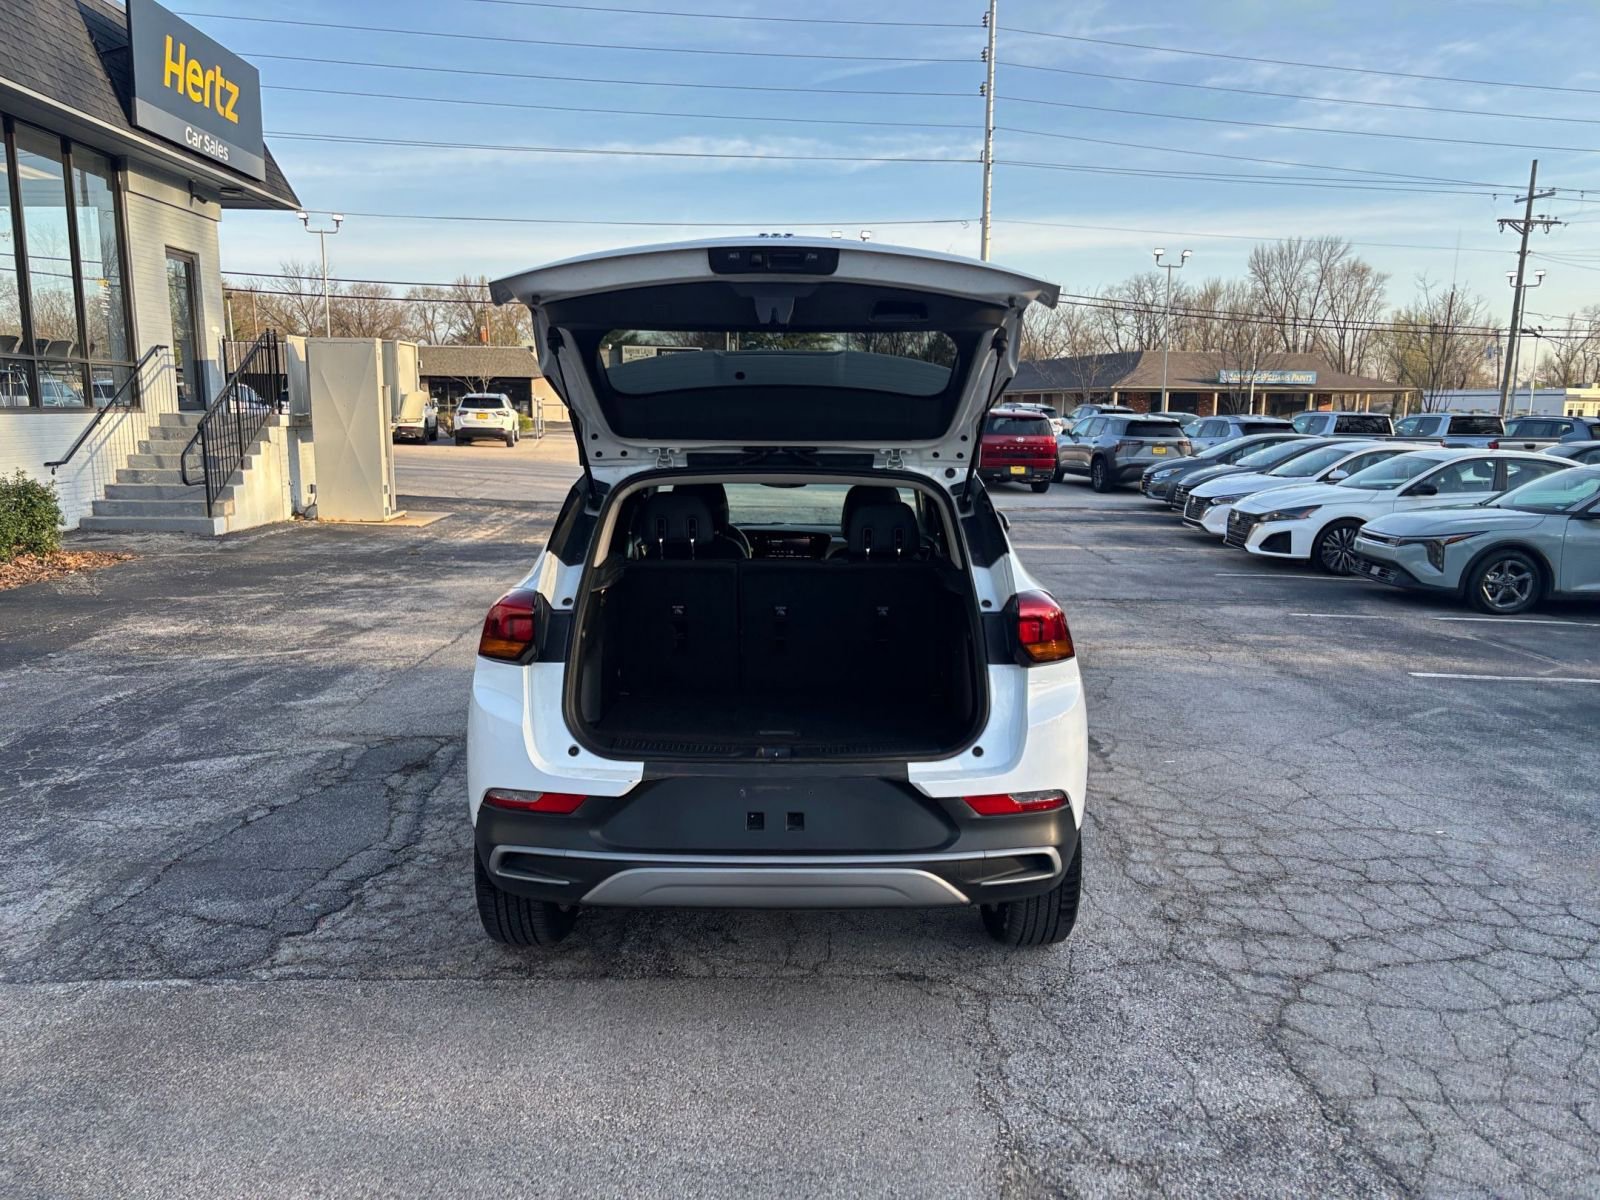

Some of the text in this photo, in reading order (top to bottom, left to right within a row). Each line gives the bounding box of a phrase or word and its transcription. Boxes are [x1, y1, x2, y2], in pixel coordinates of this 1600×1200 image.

[163, 34, 240, 124] Hertz
[185, 126, 229, 161] Car Sales
